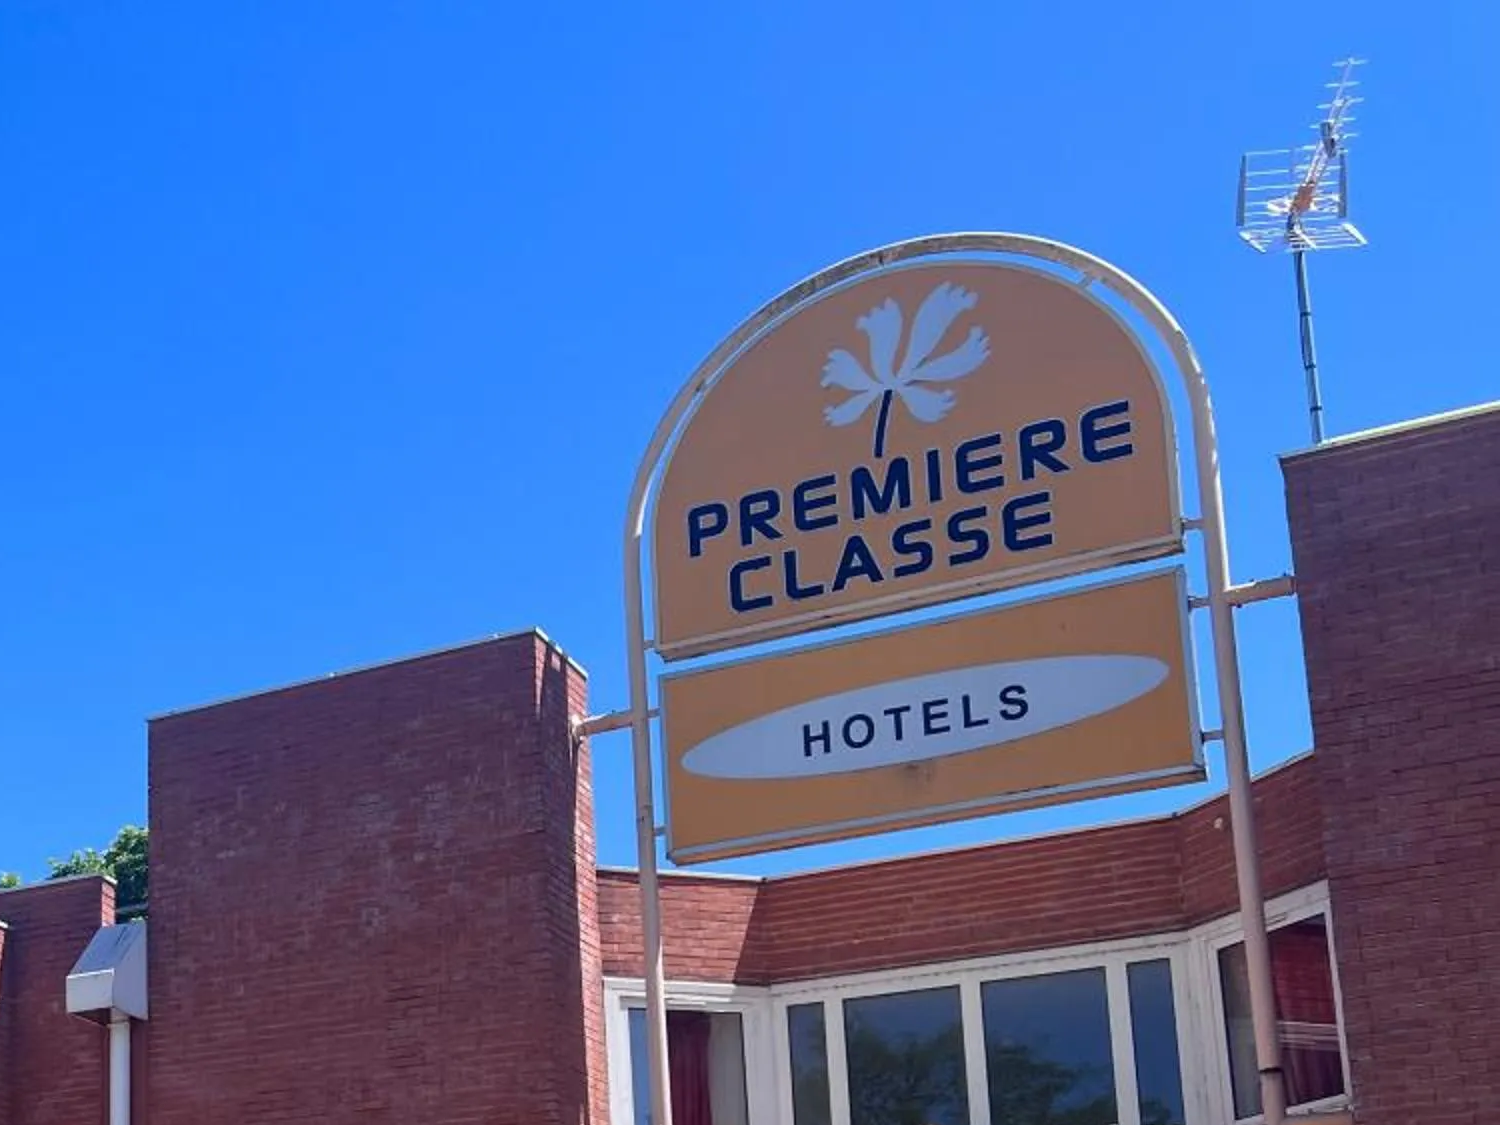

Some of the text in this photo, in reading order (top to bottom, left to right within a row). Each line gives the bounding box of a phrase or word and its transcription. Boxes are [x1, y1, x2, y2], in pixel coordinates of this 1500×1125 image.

[687, 400, 1133, 557] PREMIERE
[728, 491, 1053, 613] CLASSE
[803, 684, 1030, 758] HOTELS
